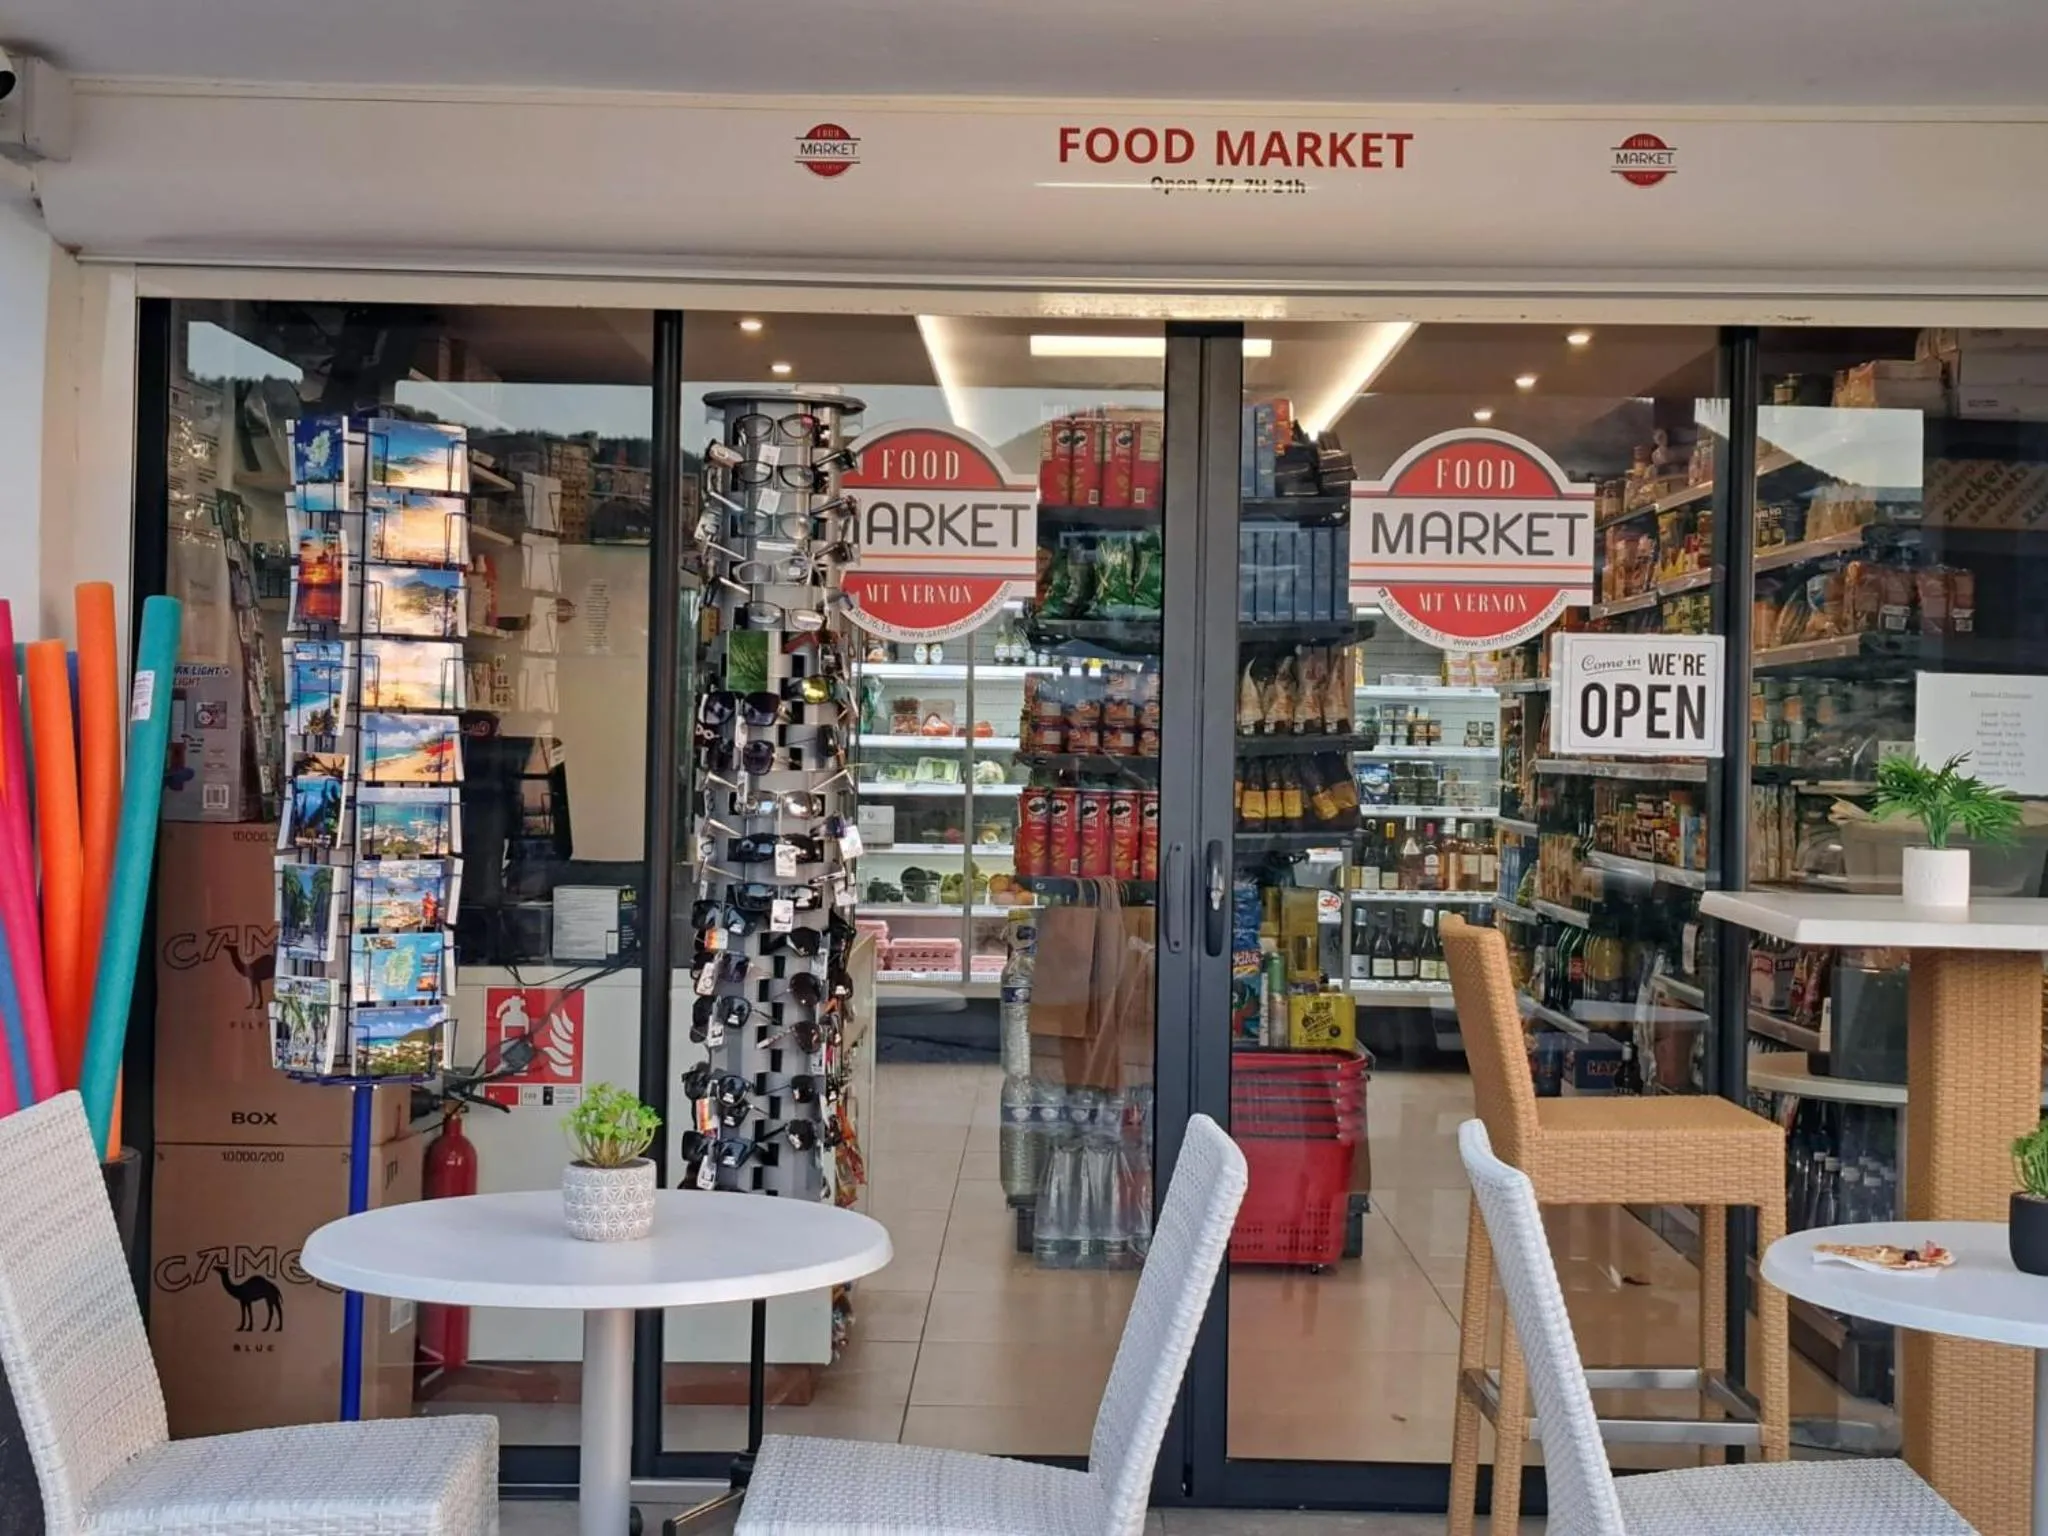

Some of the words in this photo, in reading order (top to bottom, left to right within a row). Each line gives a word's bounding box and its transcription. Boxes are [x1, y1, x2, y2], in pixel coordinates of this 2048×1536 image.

[800, 141, 858, 155] MARKET
[1059, 127, 1195, 164] FOOD
[1215, 130, 1413, 168] MARKET
[1615, 151, 1674, 165] MARKET
[1151, 175, 1198, 195] Open
[1206, 178, 1234, 194] 7/7
[883, 448, 961, 481] FOOD
[1436, 457, 1516, 491] FOOD
[1371, 510, 1588, 557] MARKET
[866, 583, 892, 604] MT
[900, 584, 972, 604] VERNON
[1419, 592, 1445, 613] MT
[1453, 592, 1528, 614] VERNON
[1581, 654, 1624, 672] Come
[1626, 655, 1641, 668] in
[1648, 653, 1706, 677] WE'RE
[1580, 681, 1706, 740] OPEN
[163, 924, 282, 971] CAM
[231, 1111, 278, 1126] BOX
[221, 1151, 284, 1164] 10000/200
[233, 1343, 275, 1353] BLUE
